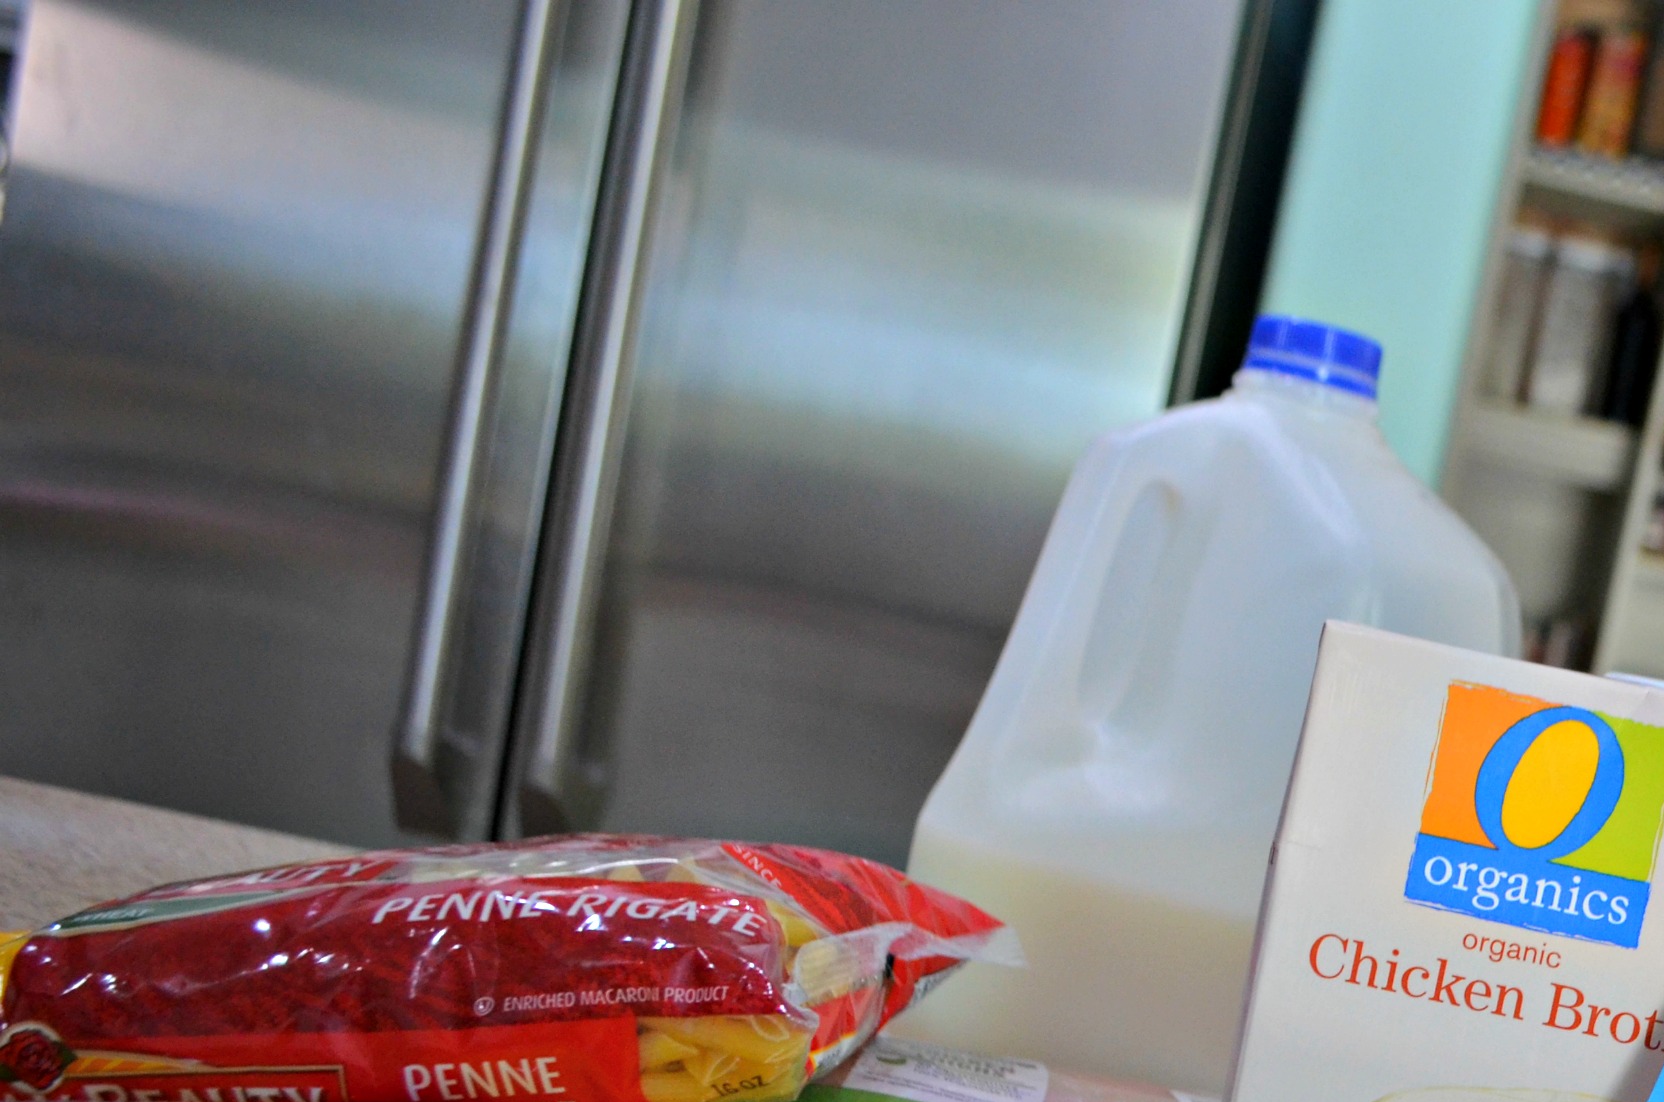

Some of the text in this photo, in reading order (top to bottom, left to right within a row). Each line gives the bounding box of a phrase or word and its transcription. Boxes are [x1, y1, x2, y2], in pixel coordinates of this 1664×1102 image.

[1423, 856, 1630, 924] organics
[372, 890, 768, 938] PENNE RIGATE
[1462, 932, 1561, 968] organic
[504, 985, 730, 1013] ENRICHED MACARONI PRODUCT
[1308, 933, 1526, 1020] Chicken
[403, 1056, 566, 1102] PENNE
[711, 1082, 740, 1097] 16
